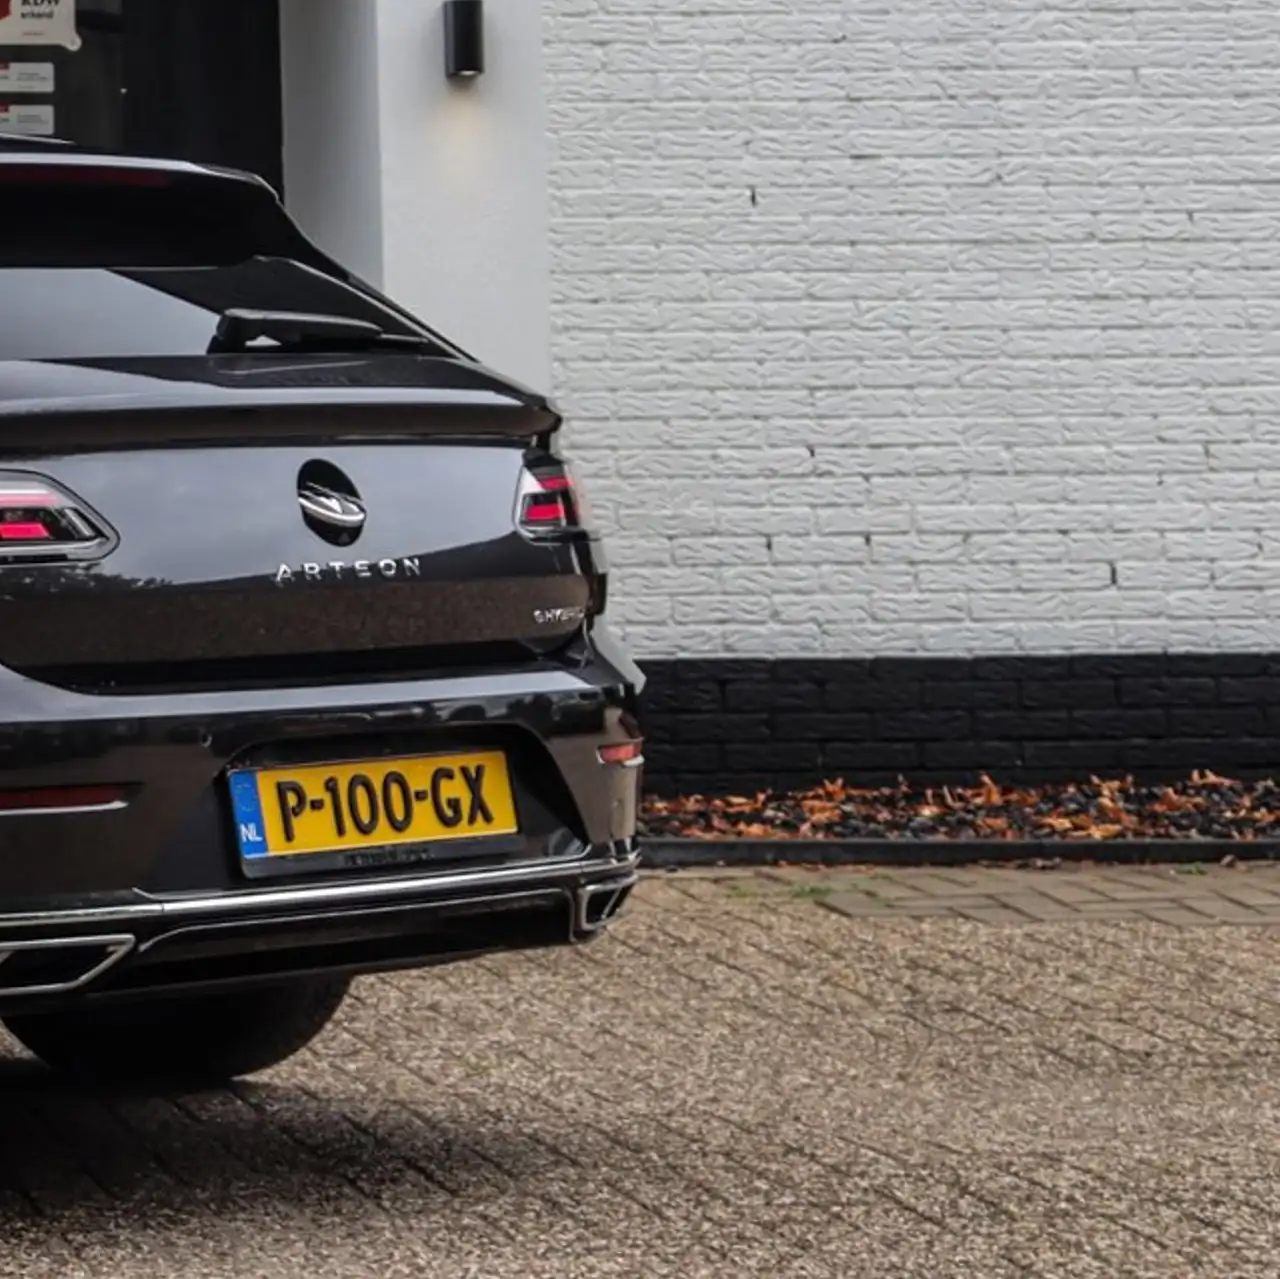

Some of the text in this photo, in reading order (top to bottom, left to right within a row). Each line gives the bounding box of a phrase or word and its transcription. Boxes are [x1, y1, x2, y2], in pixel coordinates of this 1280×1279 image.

[275, 558, 421, 583] ARTEON
[275, 764, 495, 843] P-100-GX
[240, 823, 263, 842] NL
